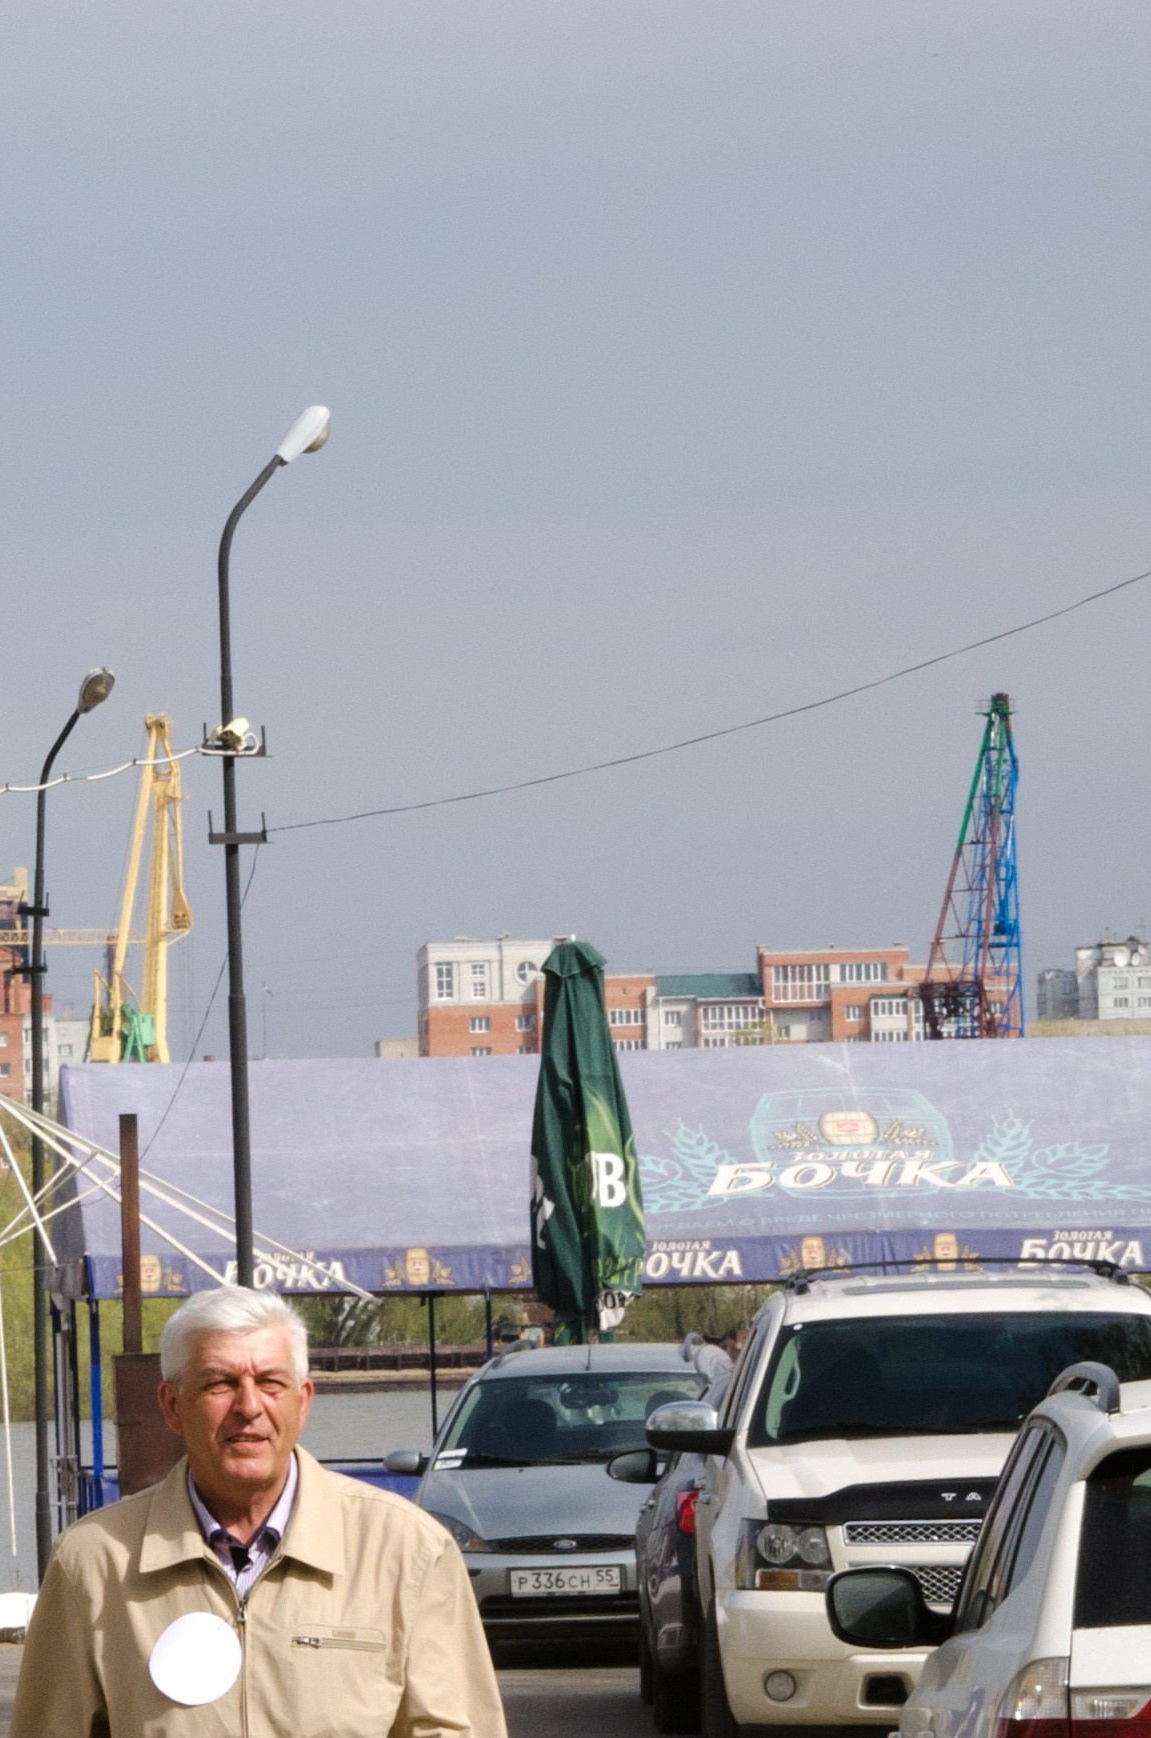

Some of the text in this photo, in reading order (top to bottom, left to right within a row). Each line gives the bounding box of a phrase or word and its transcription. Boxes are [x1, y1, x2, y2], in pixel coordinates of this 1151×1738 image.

[790, 1150, 935, 1161] ЗОЛОТАЯ
[705, 1160, 1016, 1197] БОЧКА
[1052, 1230, 1114, 1242] ЗОЛОТАЯ
[652, 1240, 711, 1251] ЗОЛОТАЯ
[1016, 1238, 1146, 1269] БОЧКА
[644, 1250, 744, 1278] ОЧКА
[941, 1491, 982, 1502] TA
